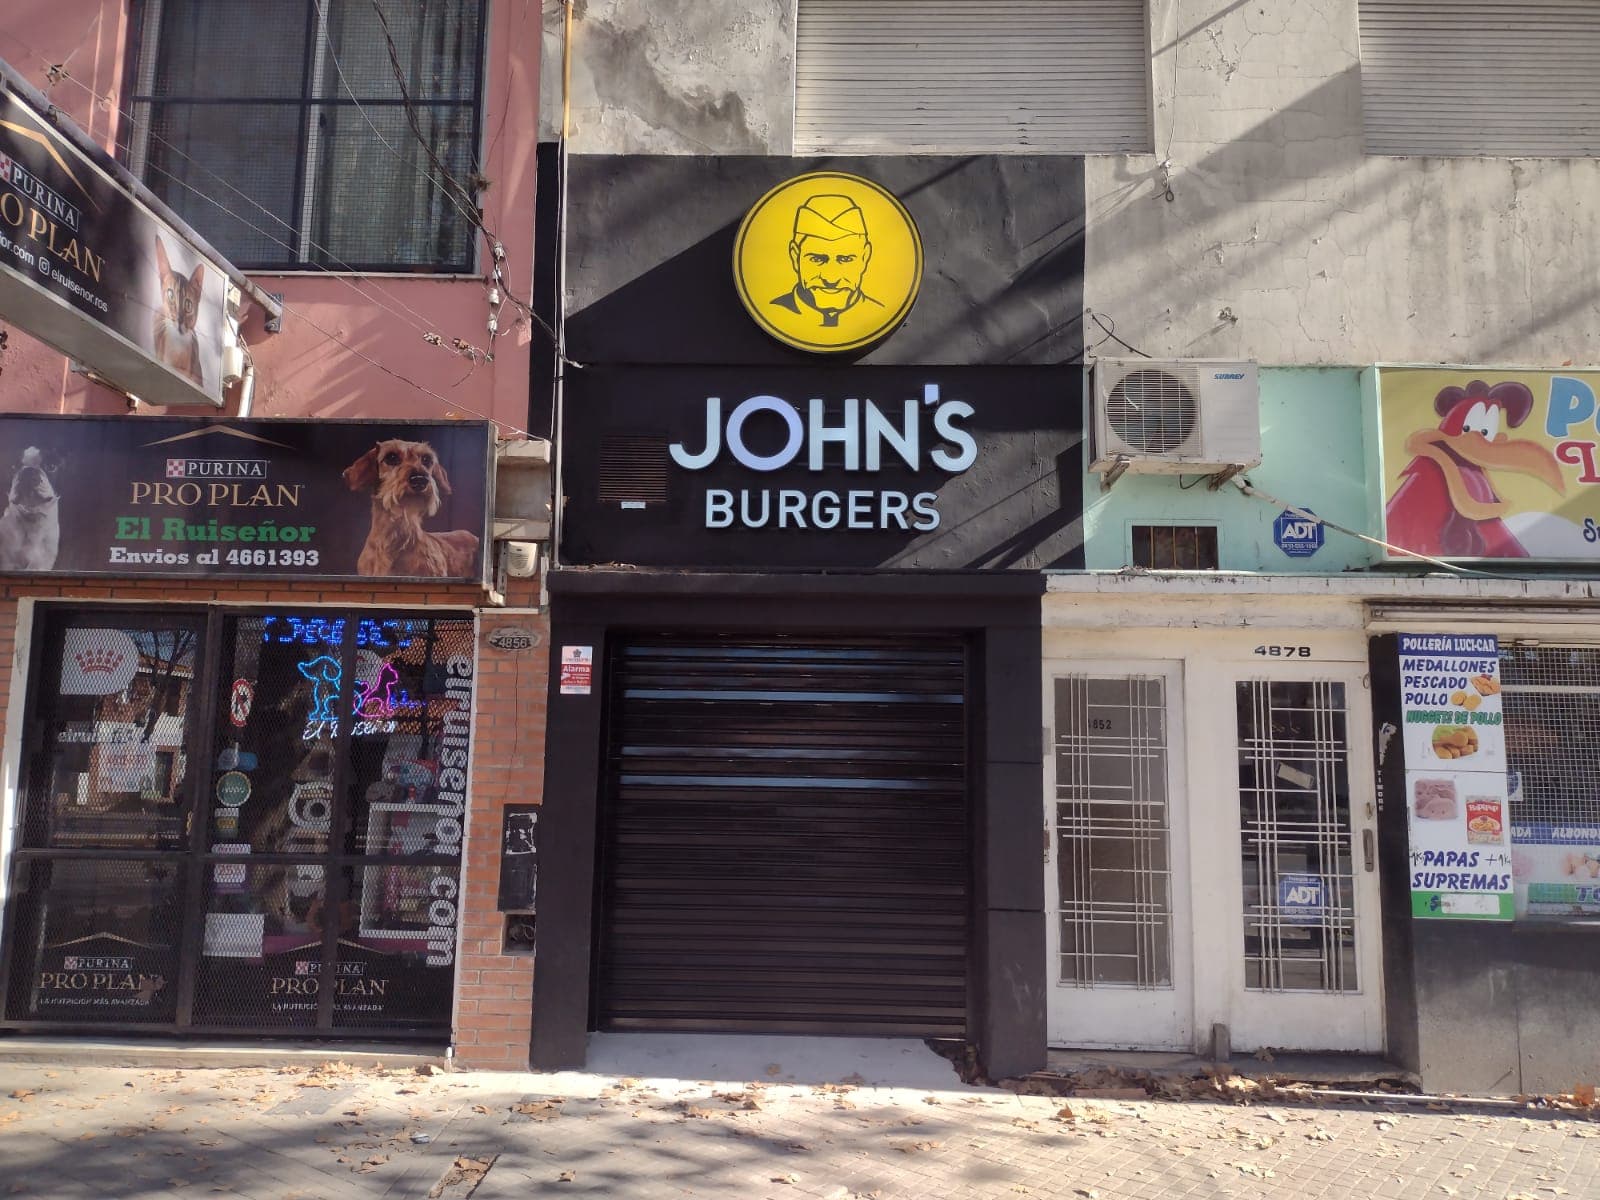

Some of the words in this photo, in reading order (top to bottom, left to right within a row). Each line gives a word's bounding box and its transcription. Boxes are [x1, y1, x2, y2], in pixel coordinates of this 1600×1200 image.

[12, 164, 75, 227] PURINA
[0, 192, 24, 226] O
[27, 207, 102, 283] PLAN
[0, 230, 34, 266] or.com
[1545, 376, 1600, 438] P
[668, 383, 978, 474] JOHN'S
[187, 461, 263, 477] PURINA
[130, 482, 202, 506] PRO
[207, 483, 301, 507] PLAN
[705, 489, 942, 532] BURGERS
[114, 516, 151, 540] El
[161, 517, 318, 543] Ruiseñor
[1281, 521, 1317, 540] ADT
[1583, 517, 1600, 543] S
[109, 546, 190, 566] Envios
[196, 549, 220, 566] al
[225, 549, 320, 567] 4661393
[1254, 645, 1311, 658] 4878
[1402, 635, 1453, 652] POLLERÍA
[1454, 638, 1496, 653] LUCI-CAR
[562, 664, 591, 674] Alarma
[1402, 658, 1497, 674] MEDALLONES
[1404, 675, 1468, 690] PESCADO
[1404, 692, 1449, 706] POLLO
[1087, 719, 1112, 731] 852
[1405, 709, 1454, 725] NUGGETS
[1454, 711, 1469, 725] DE
[1469, 711, 1503, 726] POLLO
[1422, 850, 1480, 868] PAPAS
[1412, 871, 1511, 891] SUPREMAS
[1285, 886, 1319, 905] ADT
[77, 957, 129, 969] PURINA
[310, 962, 362, 974] PINA
[40, 972, 88, 989] PRO
[270, 977, 320, 995] PRO
[333, 978, 389, 996] LAN
